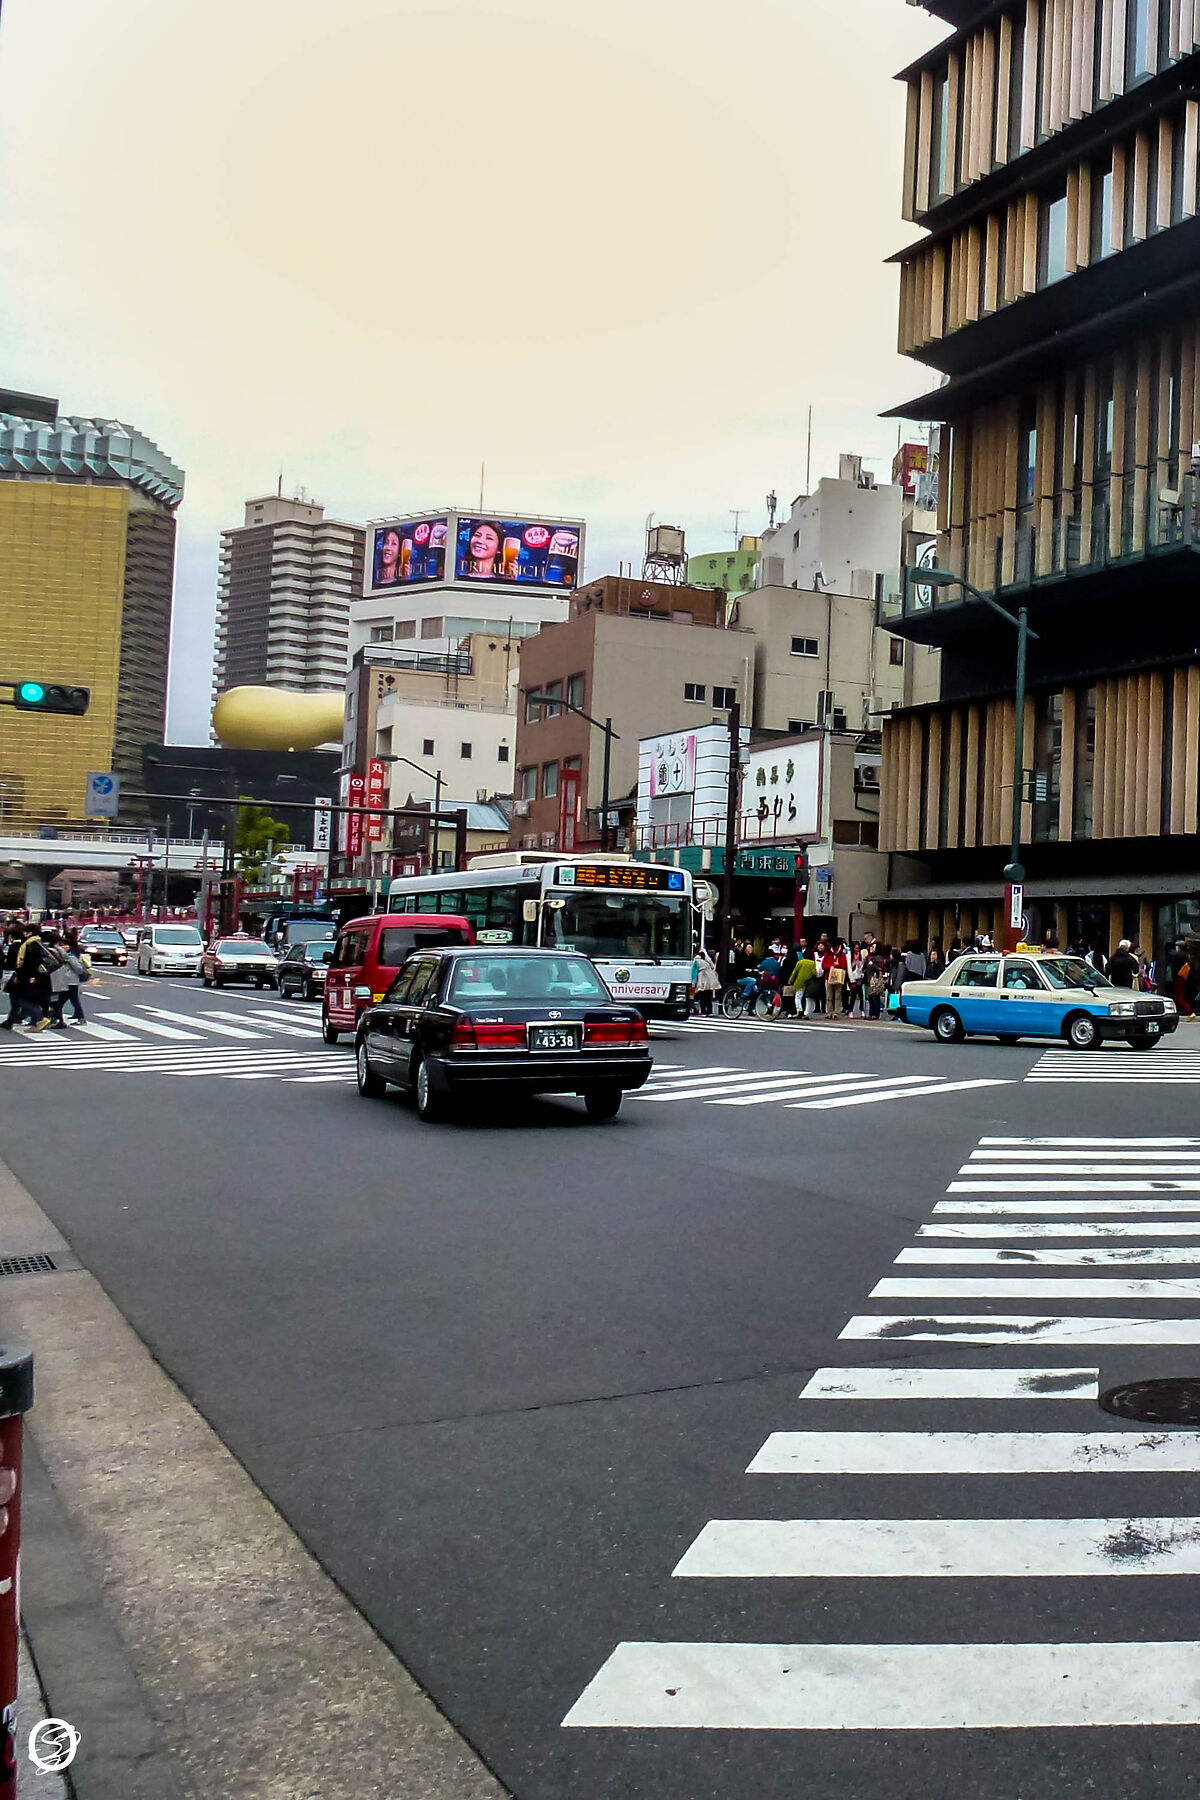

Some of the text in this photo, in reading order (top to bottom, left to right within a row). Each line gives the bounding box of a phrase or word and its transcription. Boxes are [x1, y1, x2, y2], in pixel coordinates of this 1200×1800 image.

[724, 854, 789, 873] 門東部
[608, 984, 668, 996] nniversary
[542, 1035, 574, 1047] 43-38
